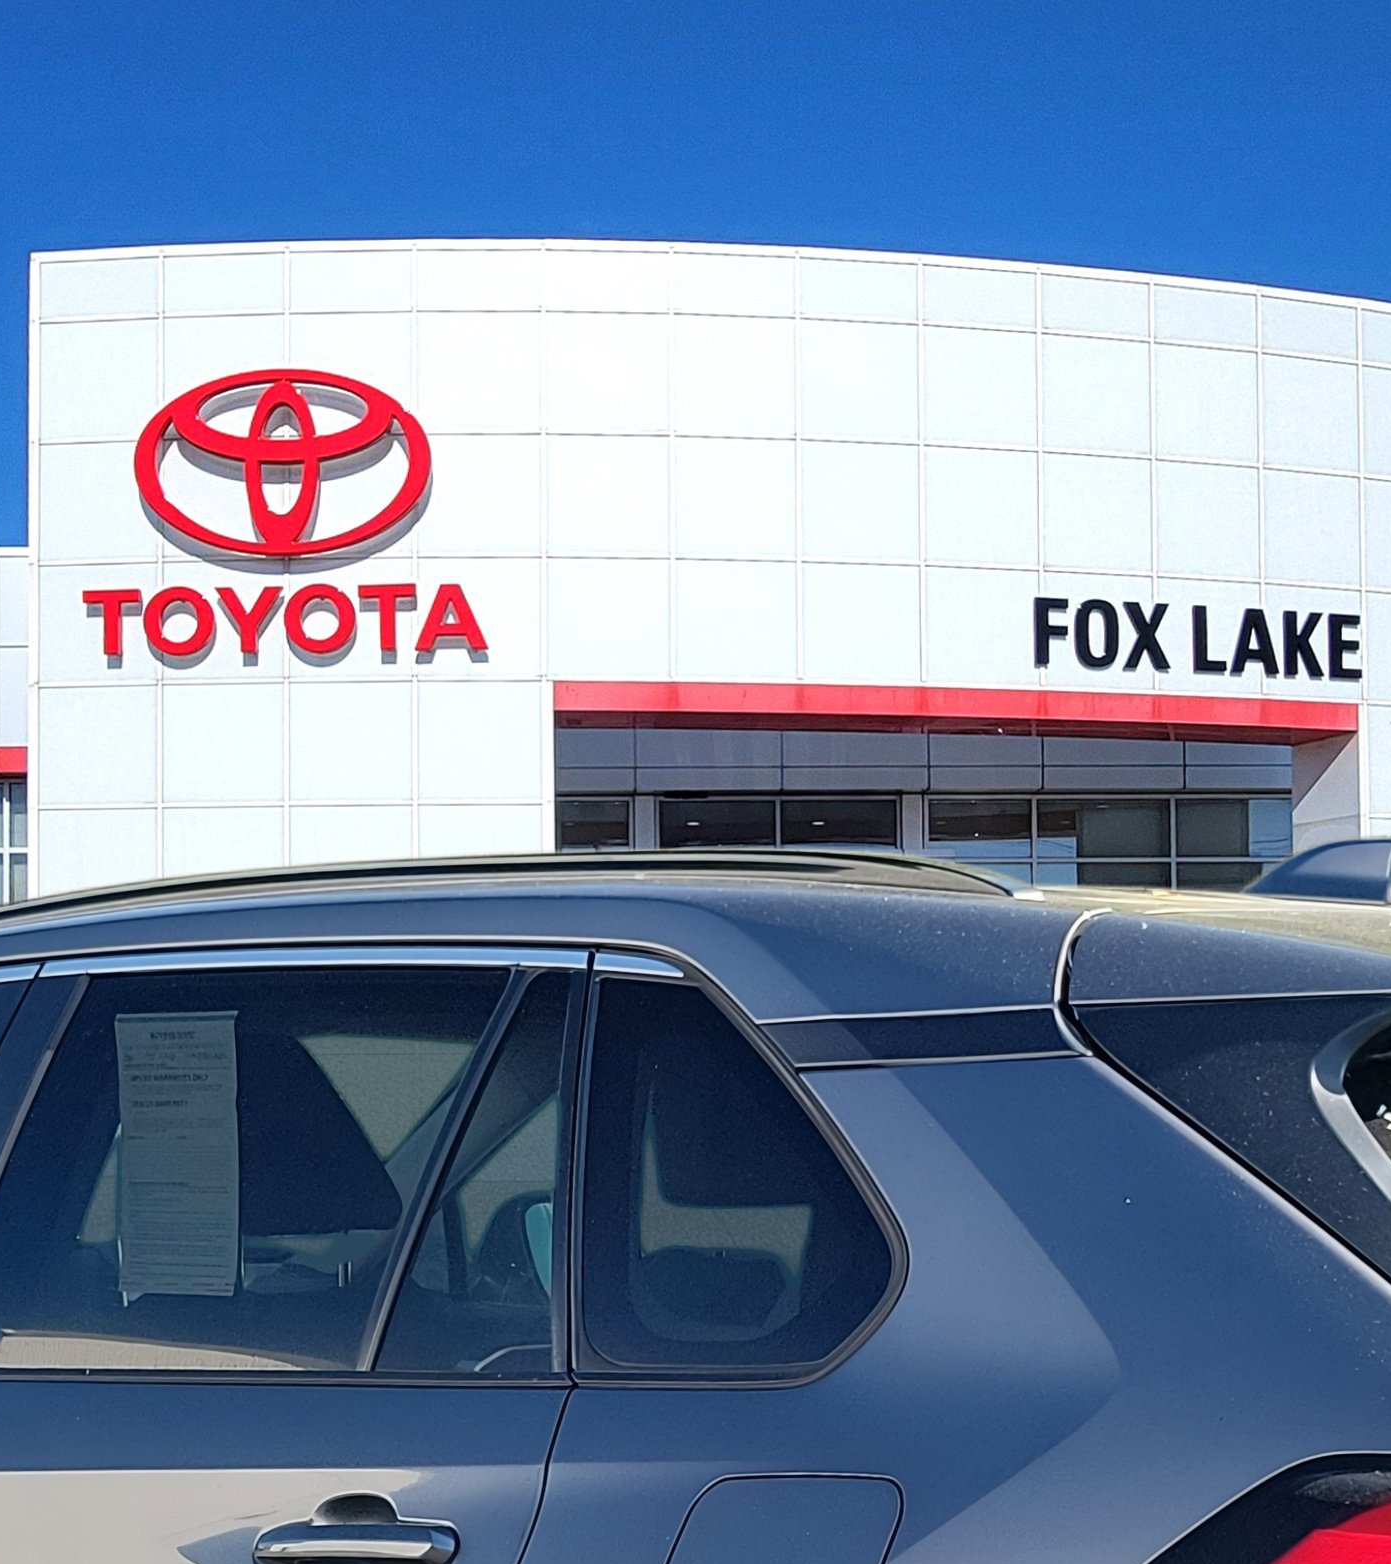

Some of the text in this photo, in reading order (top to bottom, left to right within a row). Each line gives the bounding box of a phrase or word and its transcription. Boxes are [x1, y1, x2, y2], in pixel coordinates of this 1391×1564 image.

[83, 583, 489, 657] TOYOTA
[1033, 597, 1363, 680] FOX LAKE
